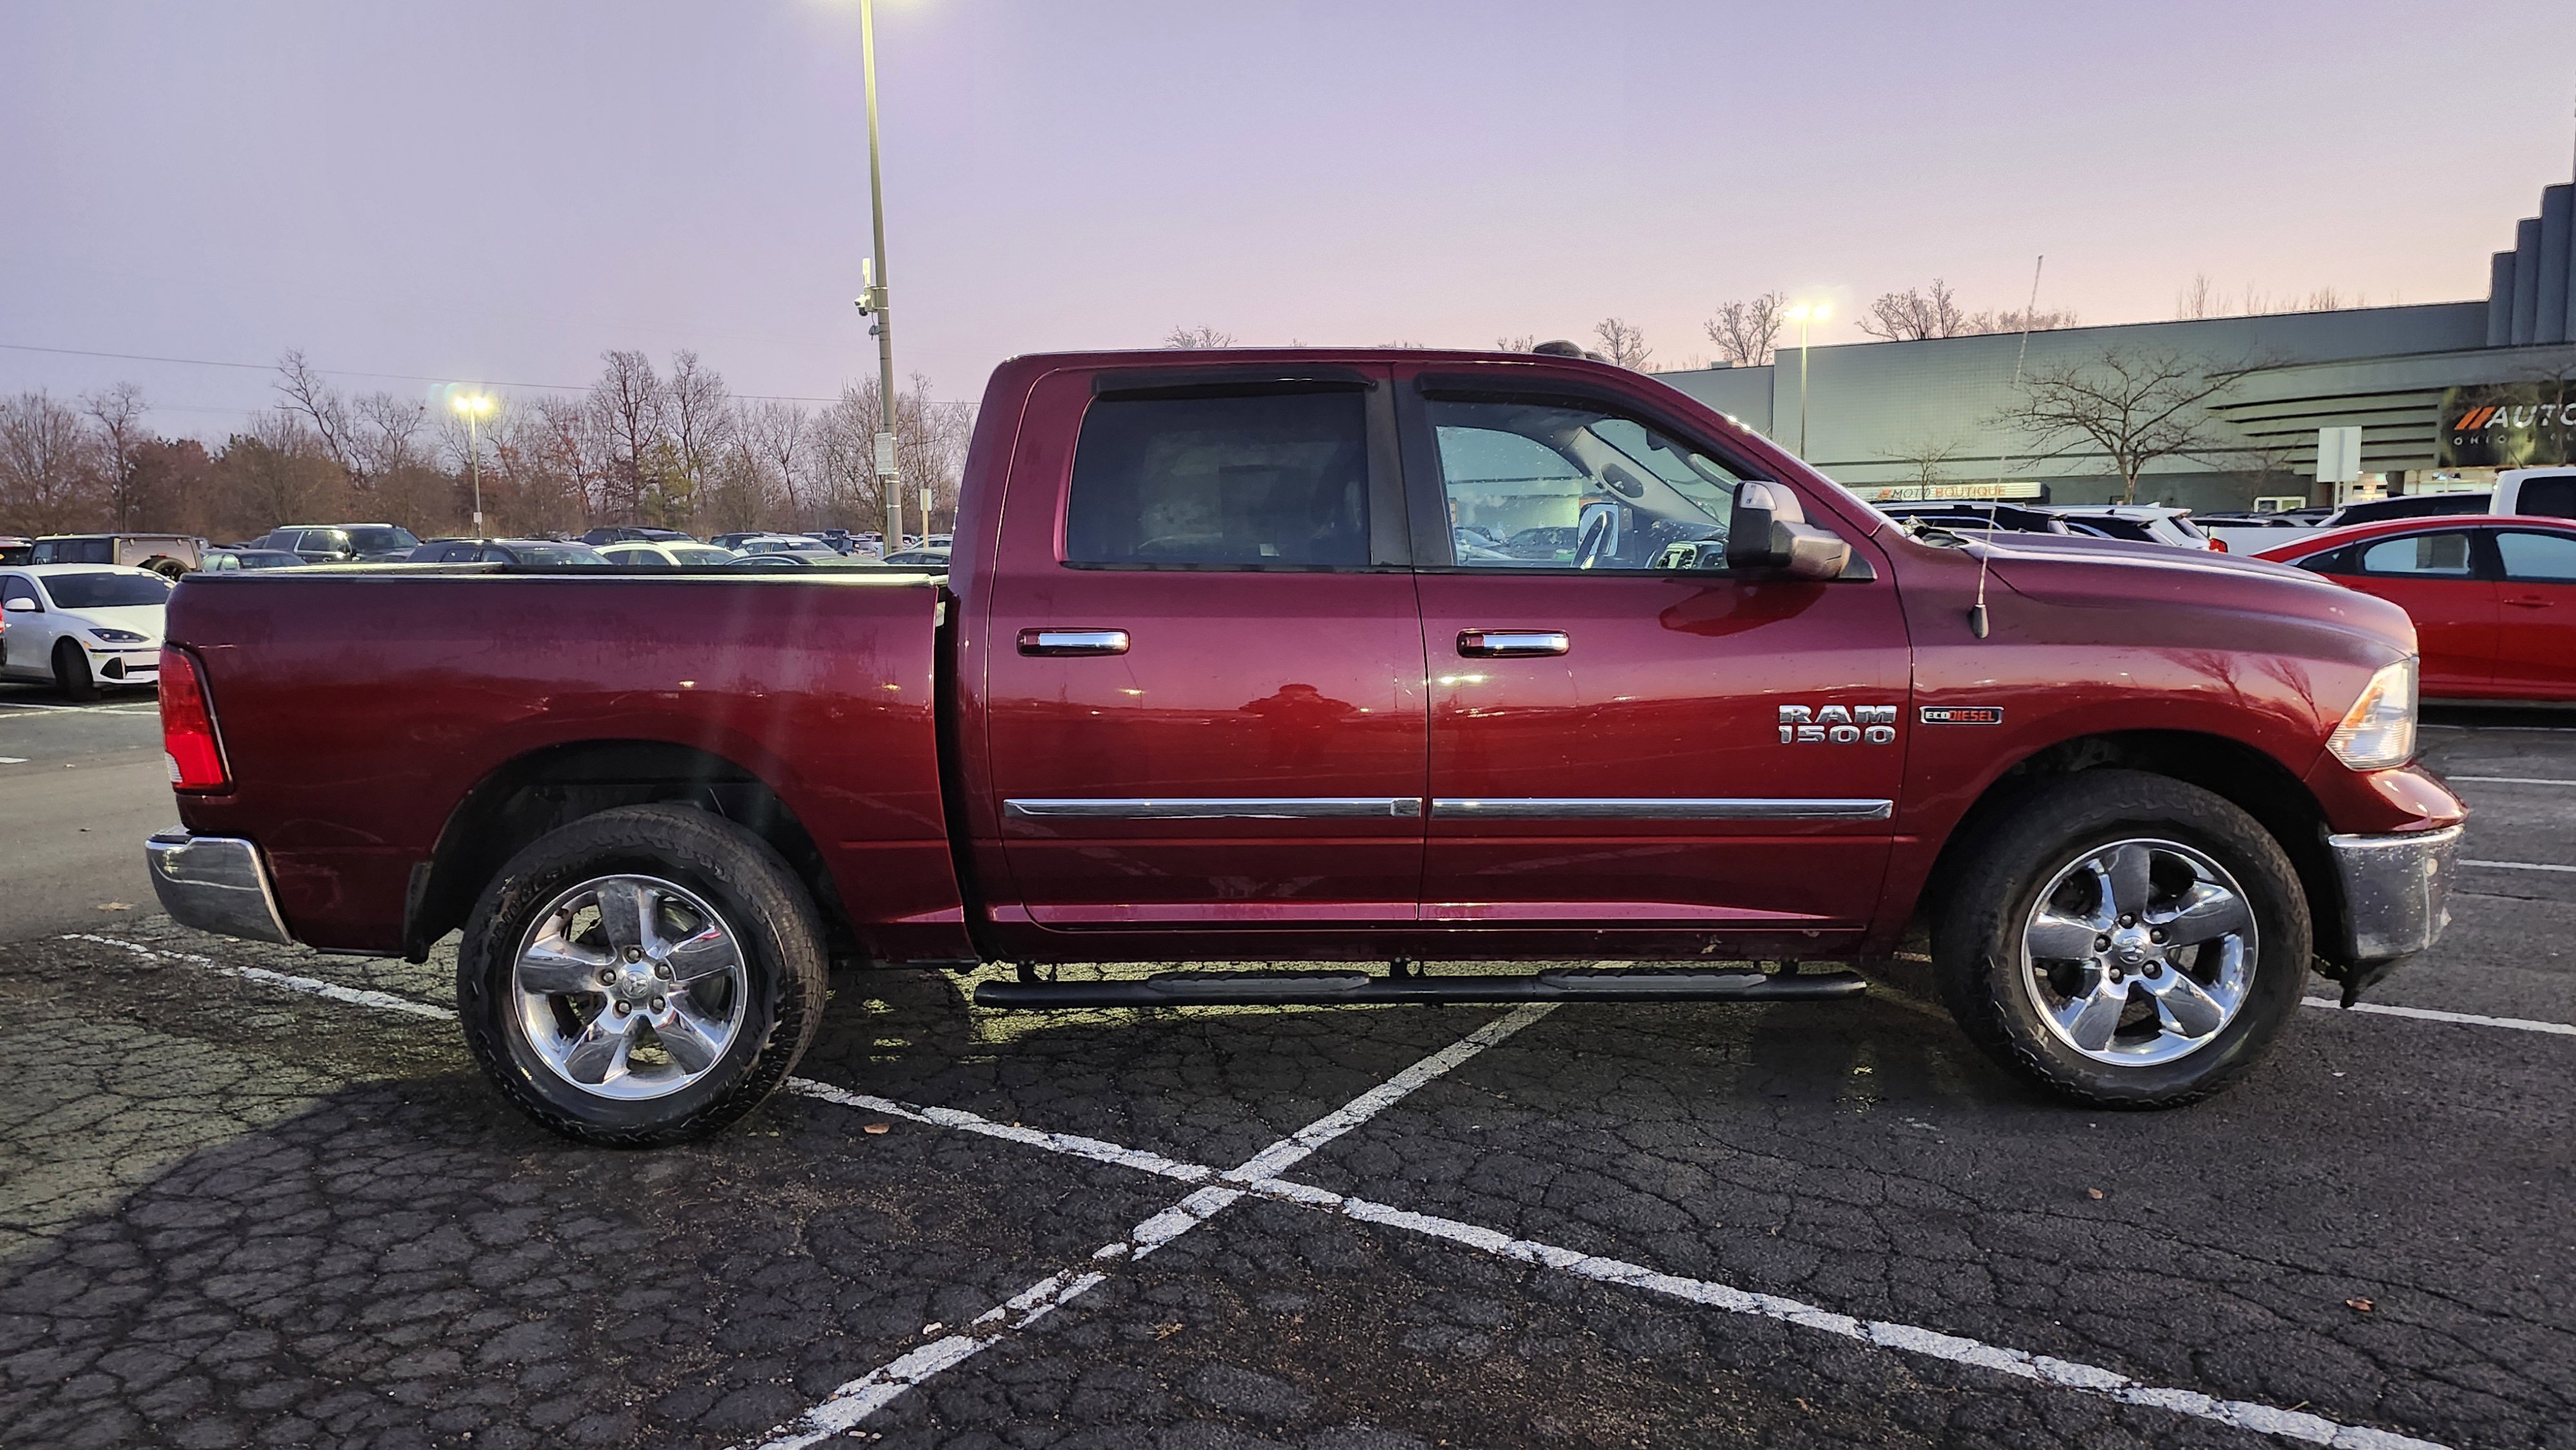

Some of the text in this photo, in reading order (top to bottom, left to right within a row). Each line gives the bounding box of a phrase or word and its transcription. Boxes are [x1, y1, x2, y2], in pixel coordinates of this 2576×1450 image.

[1891, 486, 2005, 498] MOTO BOUTIQUE
[1779, 705, 1897, 724] RAM
[1778, 725, 1896, 744] 1500
